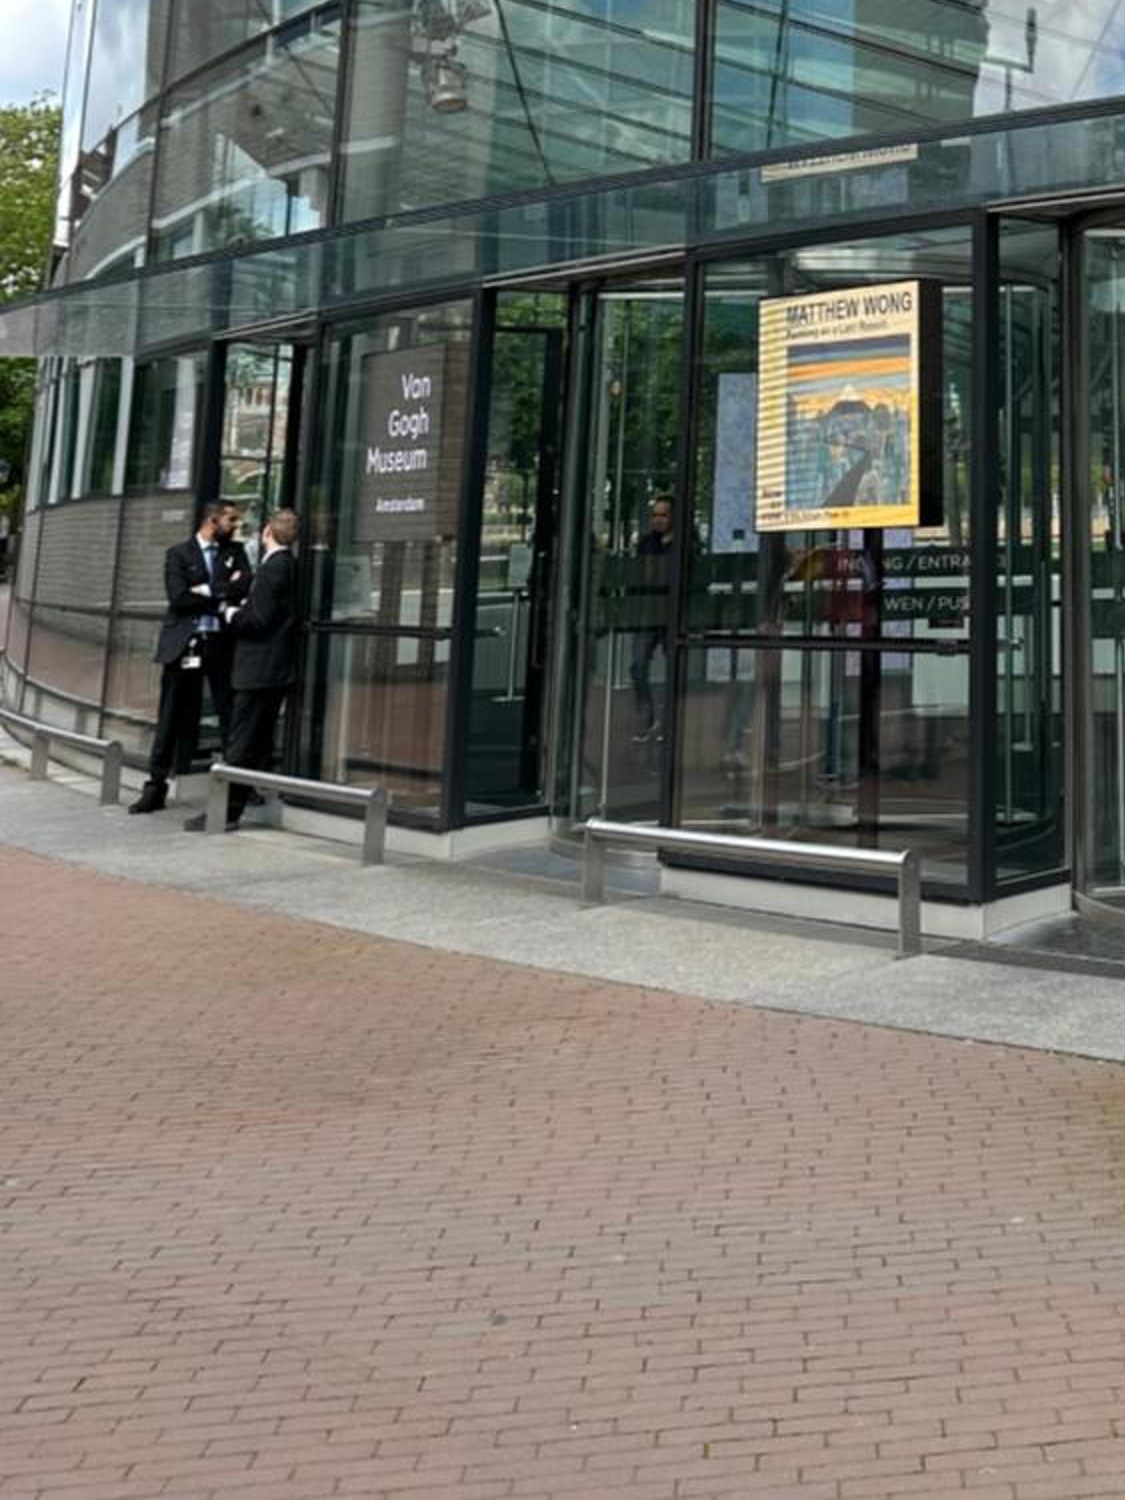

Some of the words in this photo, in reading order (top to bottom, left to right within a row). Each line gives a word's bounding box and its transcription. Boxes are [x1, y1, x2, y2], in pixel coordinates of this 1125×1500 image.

[786, 299, 861, 325] MATTHEW
[863, 291, 913, 316] WONG
[401, 373, 431, 400] Van
[387, 406, 430, 440] Gogh
[366, 446, 428, 474] Museum
[917, 553, 971, 571] ENTRA
[884, 595, 923, 611] WEN
